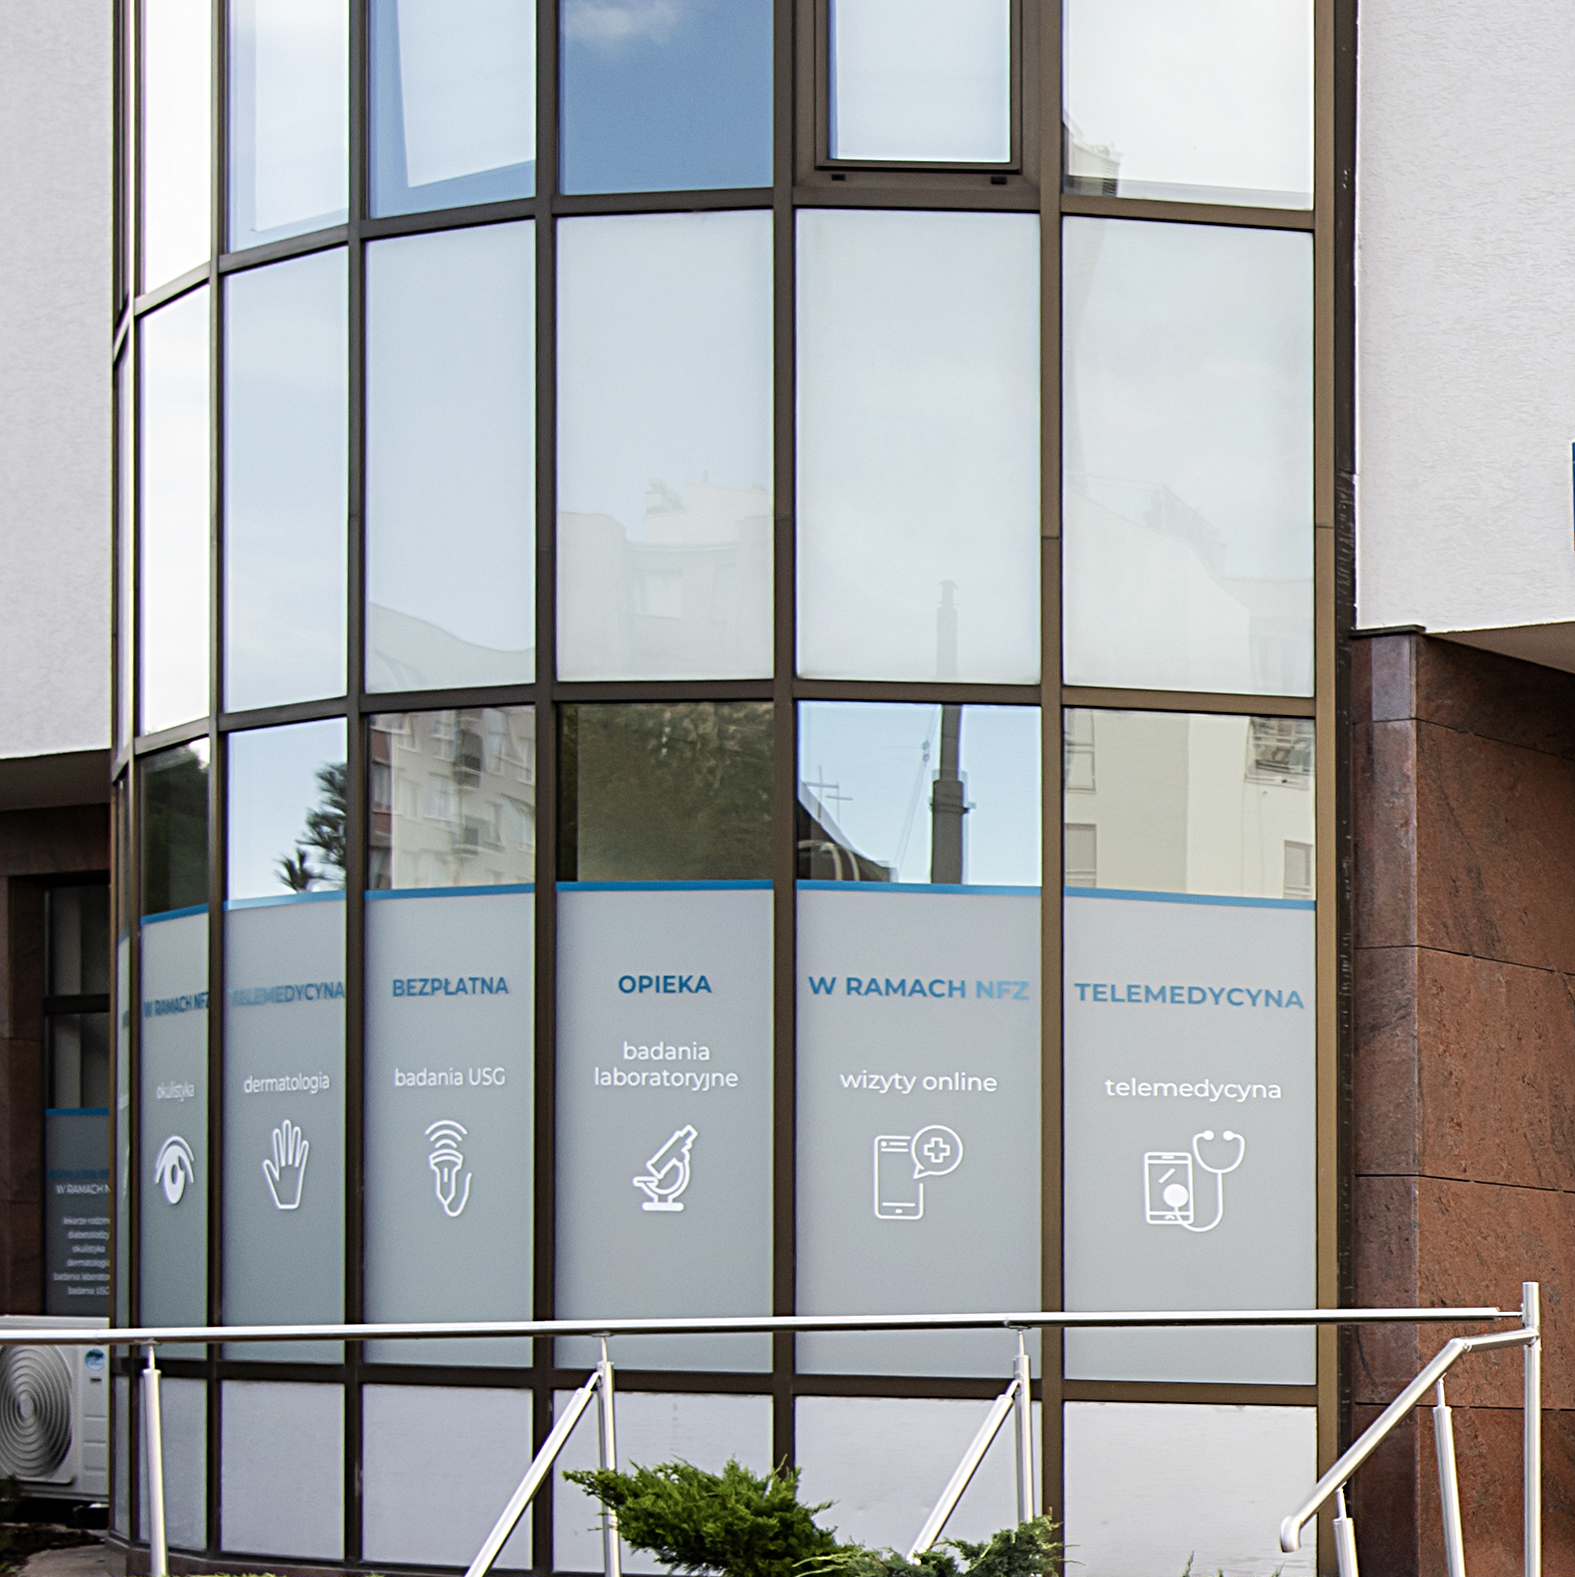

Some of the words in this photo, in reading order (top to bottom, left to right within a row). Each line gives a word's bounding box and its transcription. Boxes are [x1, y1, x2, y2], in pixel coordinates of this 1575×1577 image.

[392, 976, 509, 997] BEZPŁATNA
[618, 975, 711, 994] OPIEKA
[808, 976, 837, 995] W
[846, 977, 966, 998] RAMACH
[976, 980, 1029, 1000] NFZ
[1074, 982, 1305, 1009] TELEMEDYCYNA
[622, 1041, 710, 1061] badania
[244, 1071, 330, 1093] dermatologia
[395, 1068, 463, 1087] badania
[468, 1067, 506, 1086] USG
[594, 1067, 738, 1091] laboratoryjne
[840, 1070, 917, 1094] wizyty
[922, 1072, 998, 1092] online
[1105, 1077, 1282, 1102] telemedycyna
